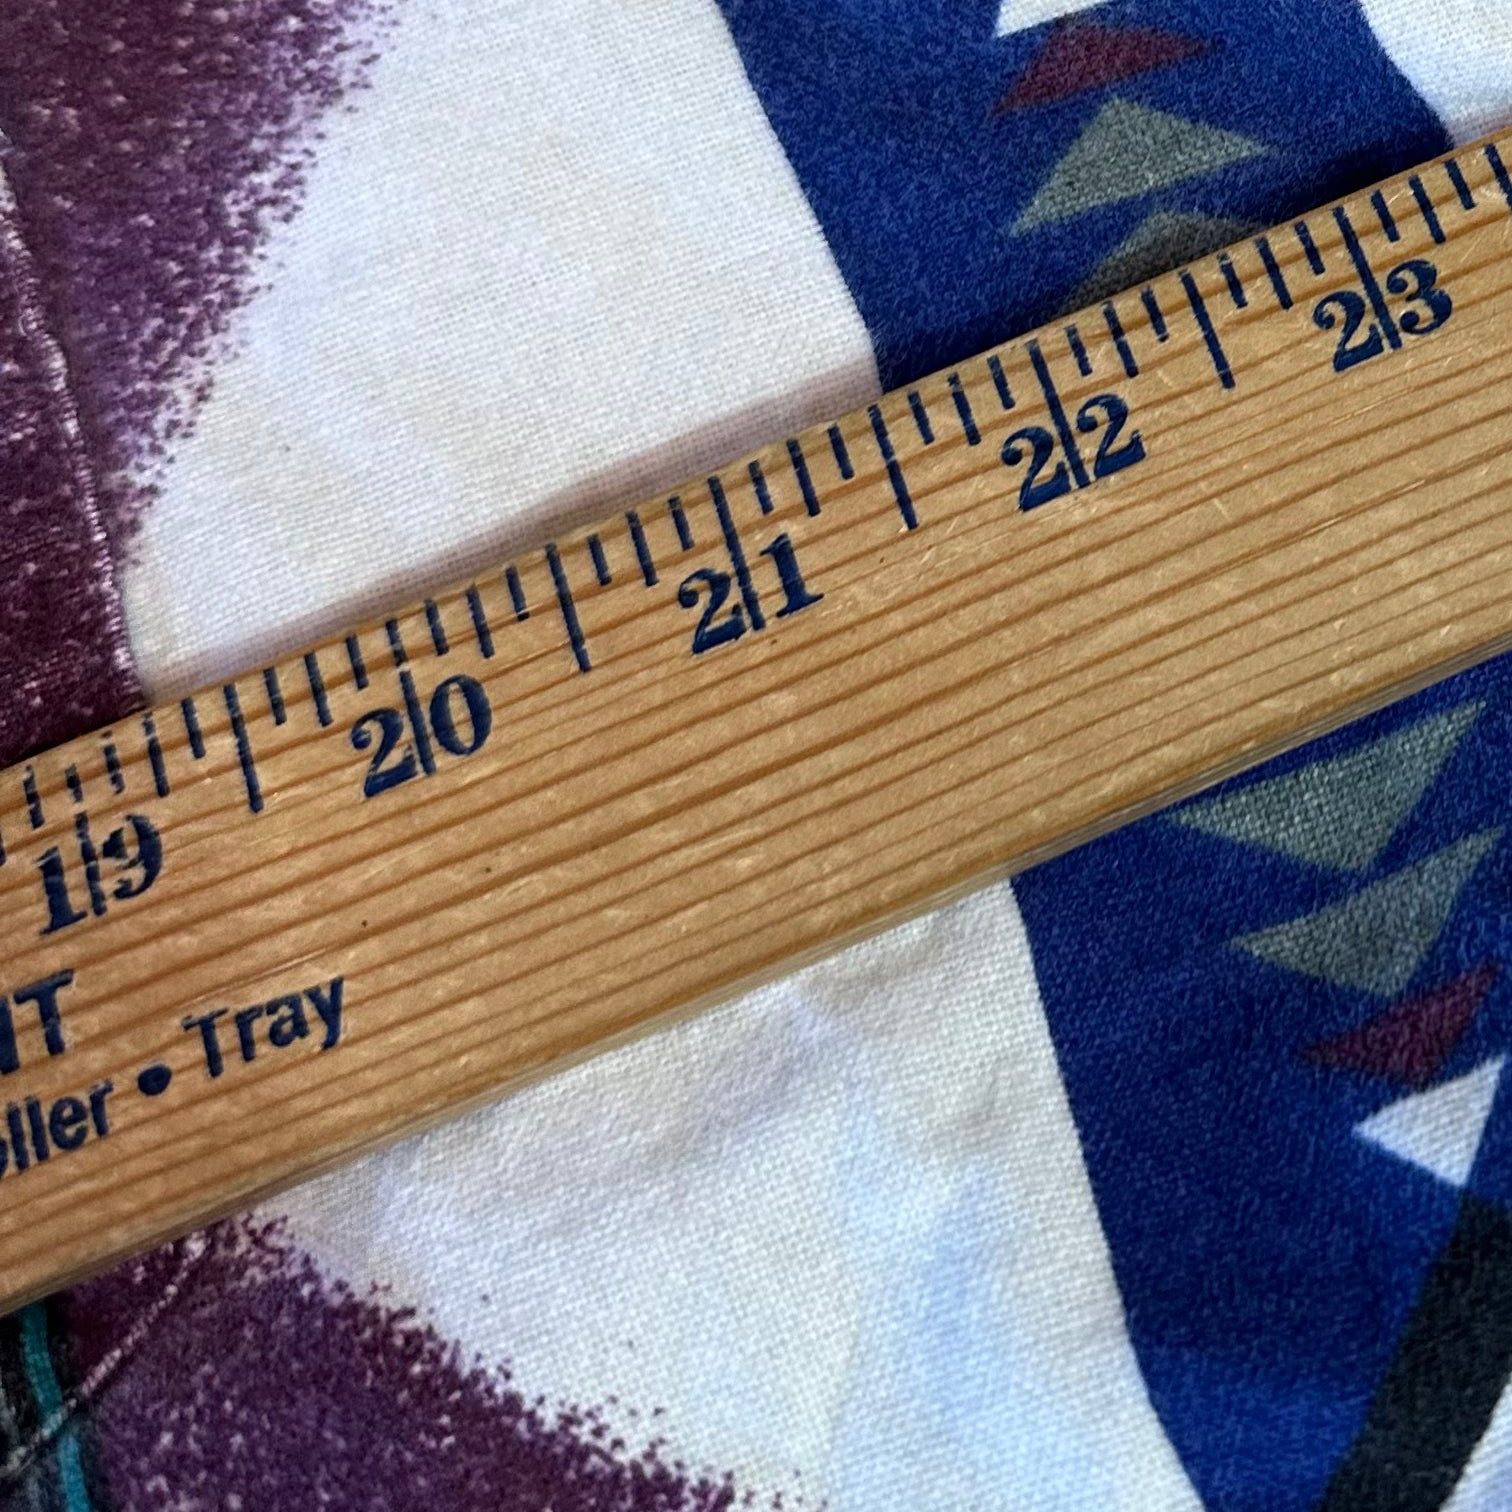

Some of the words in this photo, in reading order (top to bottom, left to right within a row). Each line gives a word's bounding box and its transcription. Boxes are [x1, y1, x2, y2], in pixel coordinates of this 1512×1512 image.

[36, 814, 163, 936] 19
[352, 675, 492, 797] 20
[679, 534, 824, 654] 21
[1002, 394, 1146, 511] 22
[1314, 260, 1454, 371] 23
[0, 1079, 114, 1180] ller
[181, 977, 346, 1078] Tray
